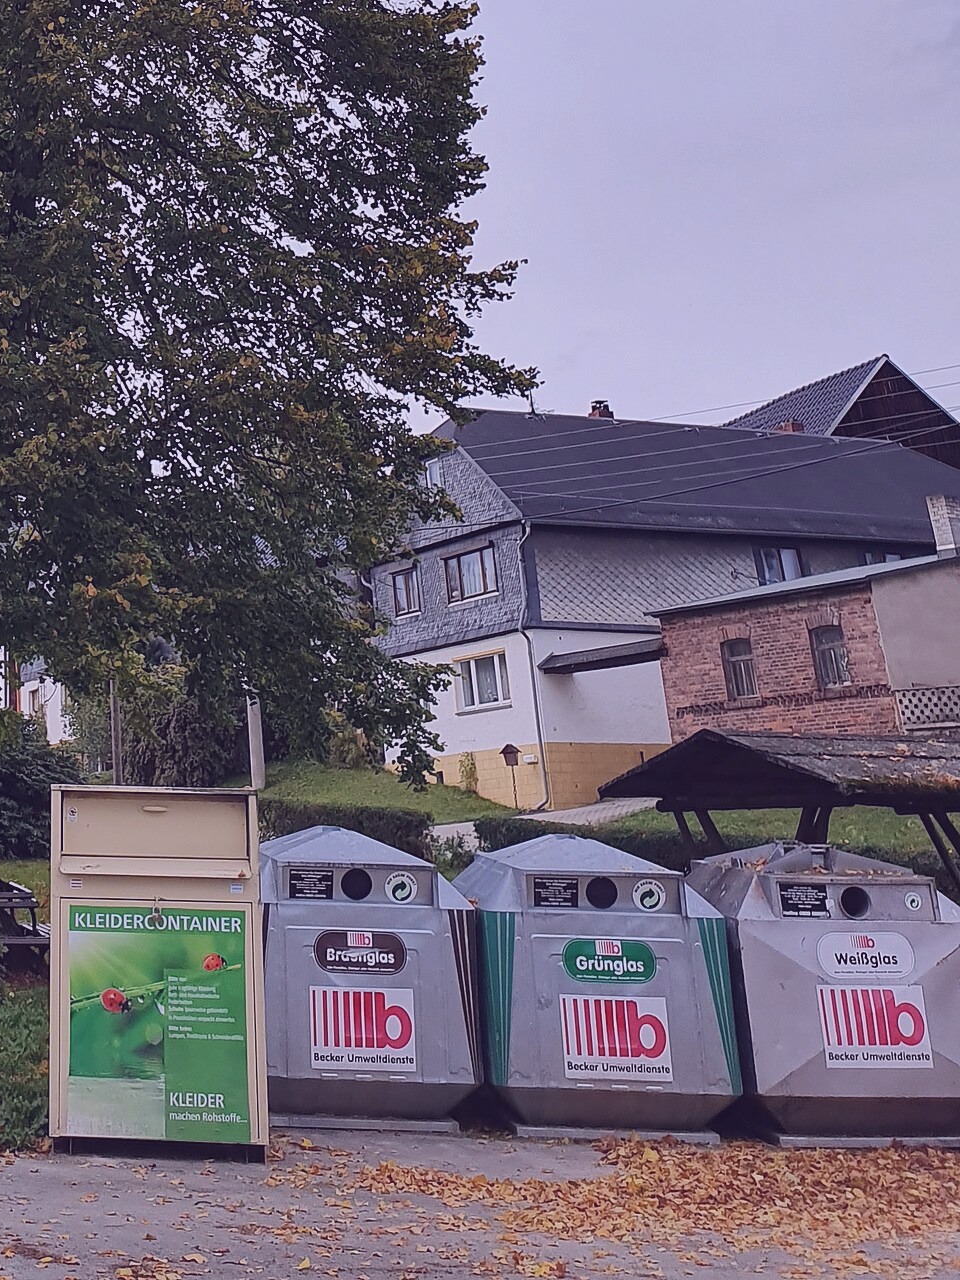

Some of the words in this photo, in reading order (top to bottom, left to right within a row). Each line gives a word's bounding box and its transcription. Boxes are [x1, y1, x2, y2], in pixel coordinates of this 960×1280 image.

[74, 912, 242, 933] KLEIDERCONTAINER
[575, 955, 645, 975] Grünglas
[834, 951, 898, 969] Weißglas
[313, 1052, 344, 1062] Becker
[347, 1053, 415, 1064] Umweltdienste
[828, 1051, 859, 1061] Becker
[862, 1051, 930, 1061] Umweltdienste
[567, 1061, 599, 1072] Becker
[601, 1062, 671, 1074] Umweltdienste
[169, 1091, 225, 1109] KLEIDER
[169, 1111, 201, 1121] machen
